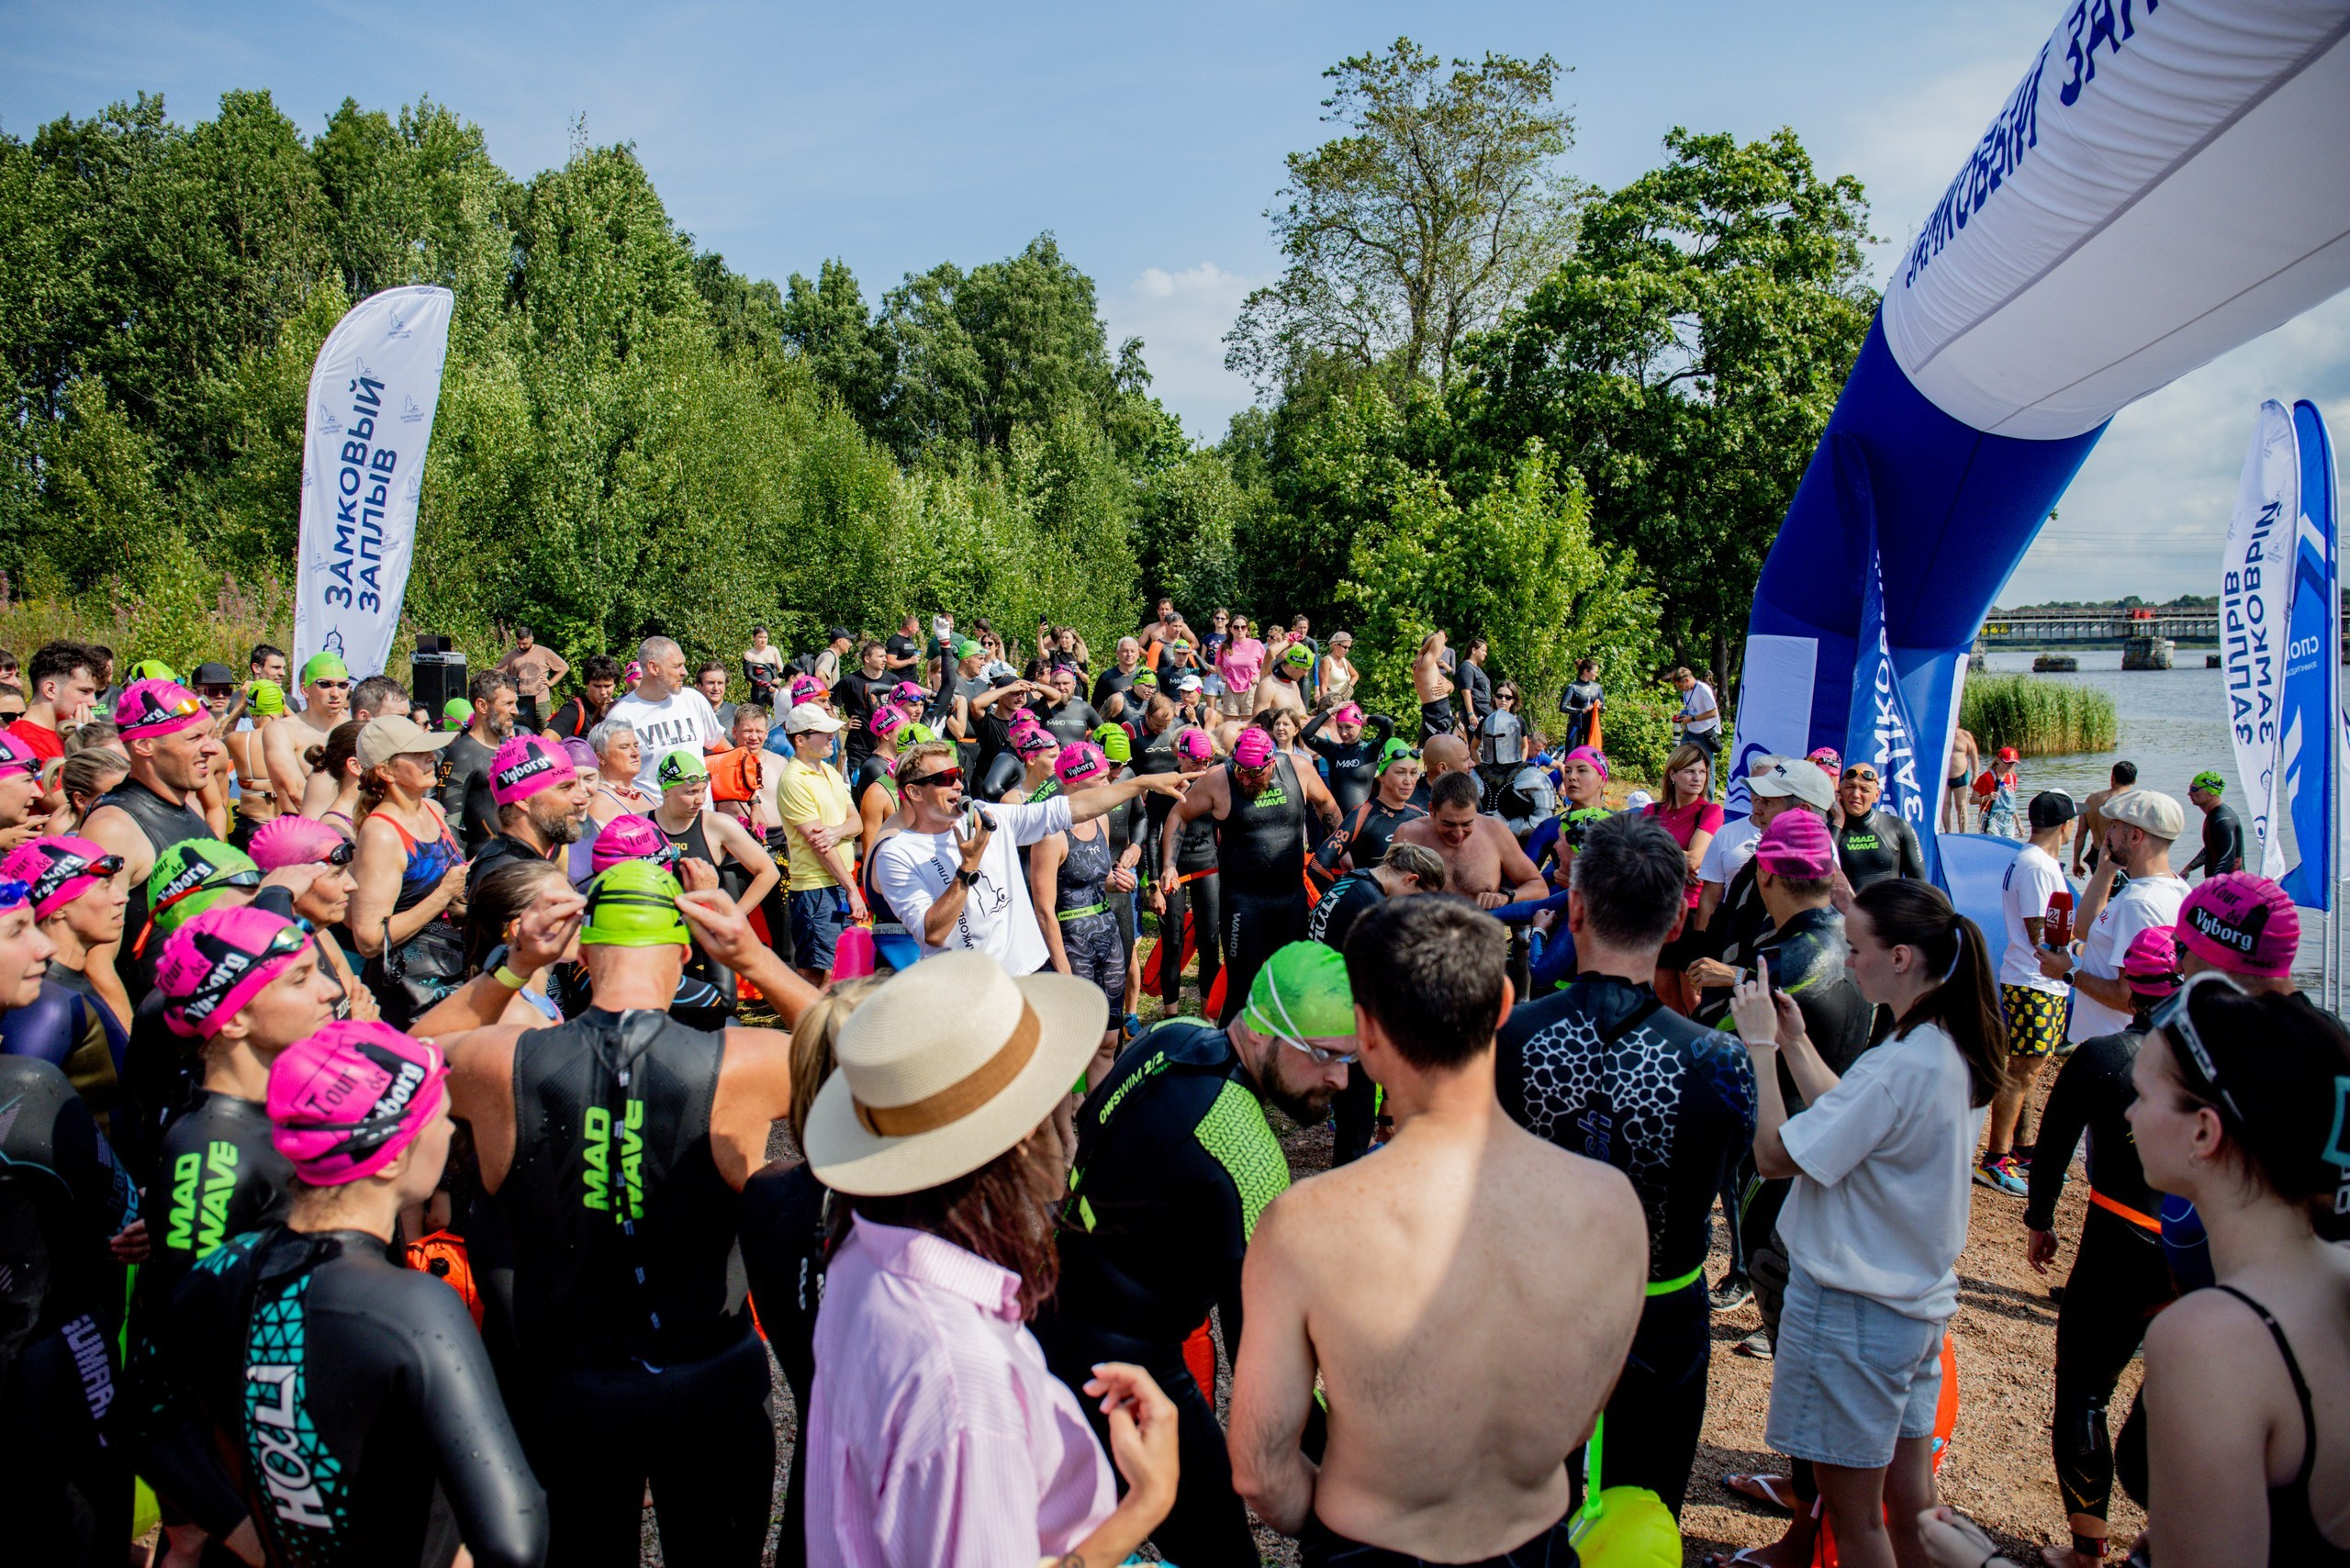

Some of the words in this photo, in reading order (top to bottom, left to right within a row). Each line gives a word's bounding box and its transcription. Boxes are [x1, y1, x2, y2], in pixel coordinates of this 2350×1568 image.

[324, 376, 386, 610] ЗАМКОВЫЙ
[359, 448, 397, 614] ЗАПЛЫВ
[497, 745, 517, 764] Tour
[517, 753, 529, 763] de
[498, 756, 553, 786] Vyborg
[1066, 761, 1096, 778] Vyborg
[1254, 796, 1288, 809] WAVE
[1257, 787, 1283, 799] MAD
[625, 832, 652, 848] Tour
[1846, 842, 1880, 851] WAVE
[1849, 834, 1876, 844] MAD
[171, 861, 184, 875] de
[2211, 881, 2244, 907] Tour
[2195, 906, 2253, 951] Vyborg
[2225, 908, 2243, 925] de
[1230, 912, 1242, 958] WAHOO
[189, 958, 208, 979] de
[1144, 1050, 1165, 1075] 2/2
[303, 1068, 359, 1117] Tour
[582, 1105, 611, 1212] MAD
[615, 1098, 644, 1226] WAVE
[165, 1151, 203, 1250] MAD
[196, 1140, 239, 1260] WAVE
